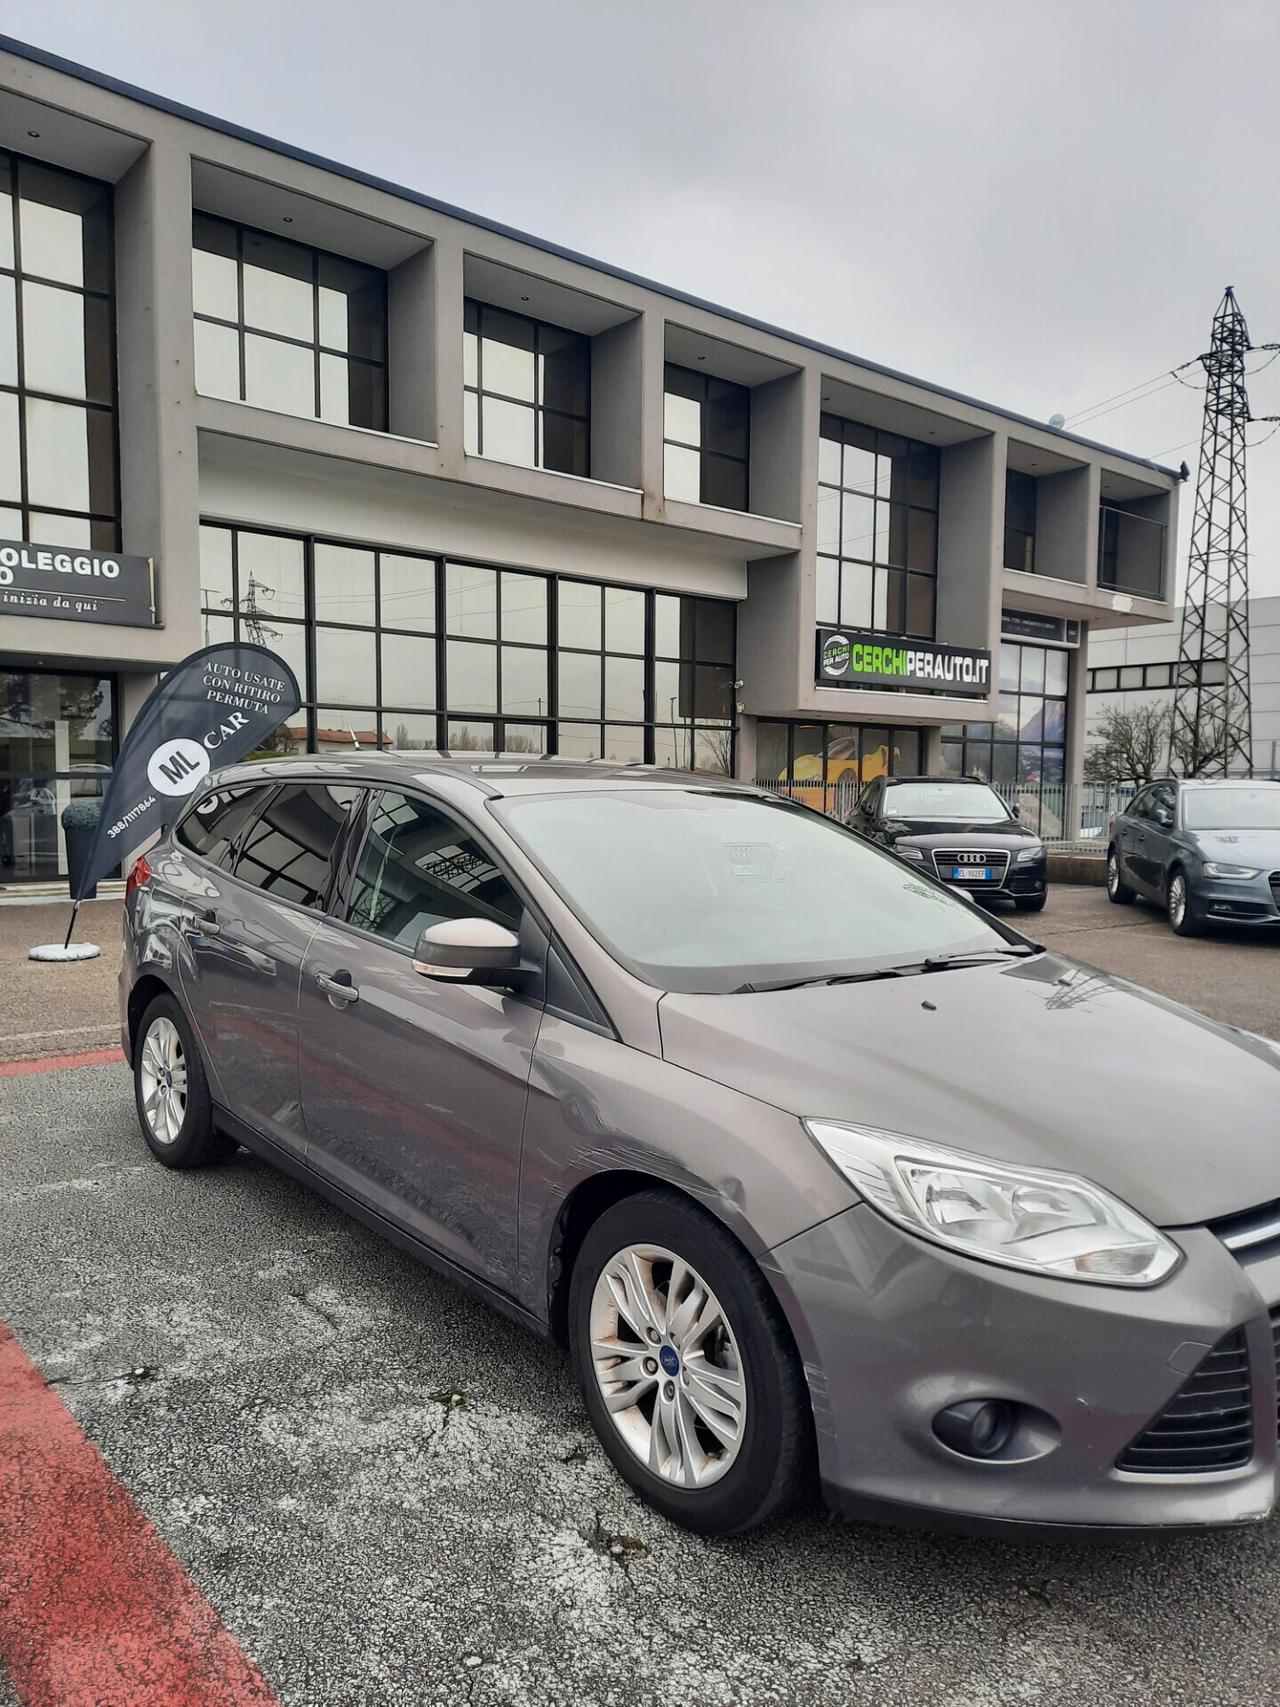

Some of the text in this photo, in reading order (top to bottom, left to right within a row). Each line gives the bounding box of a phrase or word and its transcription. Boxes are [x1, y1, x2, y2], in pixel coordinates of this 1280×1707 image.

[0, 547, 120, 578] OLEGGIO
[3, 591, 98, 613] inizia da qui
[823, 644, 850, 659] CERCHI
[852, 643, 989, 684] CERCHIPERAUTO.IT
[203, 661, 286, 692] AUTO USATE
[203, 675, 281, 703] CON RITIRO
[206, 689, 269, 714] PERMUTA
[158, 711, 250, 785] ML CAR
